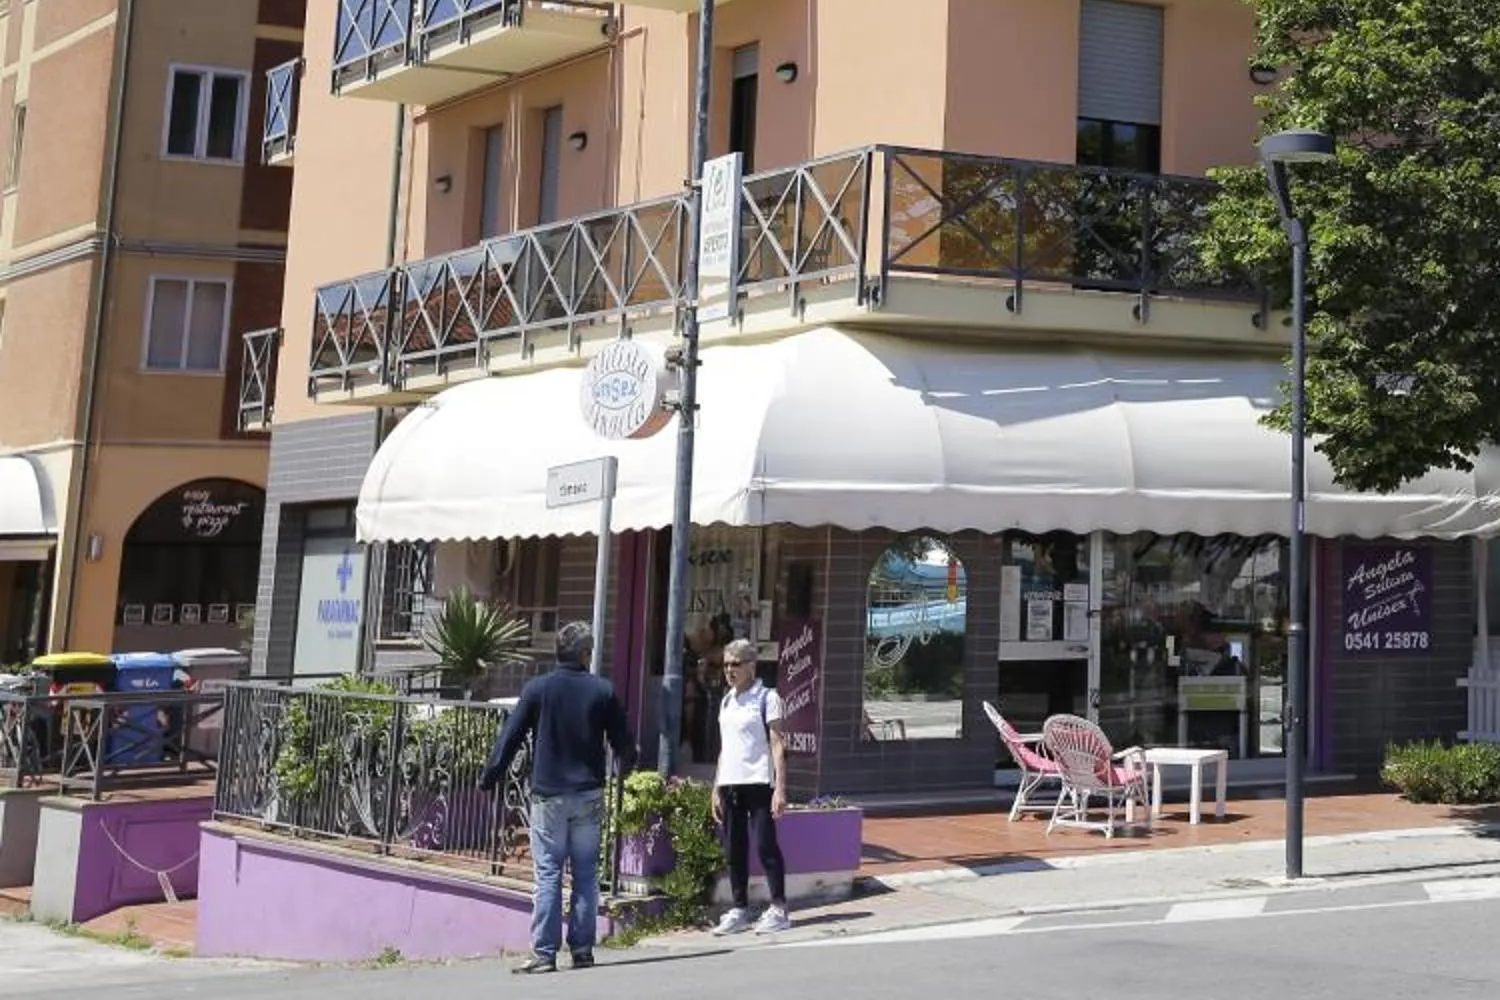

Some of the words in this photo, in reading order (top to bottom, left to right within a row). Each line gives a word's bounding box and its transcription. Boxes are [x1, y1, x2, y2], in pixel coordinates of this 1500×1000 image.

[1347, 550, 1416, 592] Angela
[1364, 571, 1415, 600] Stilista
[1347, 599, 1409, 630] Unisex
[780, 624, 814, 664] Angela
[1345, 631, 1380, 651] 0541
[1384, 630, 1430, 650] 25878
